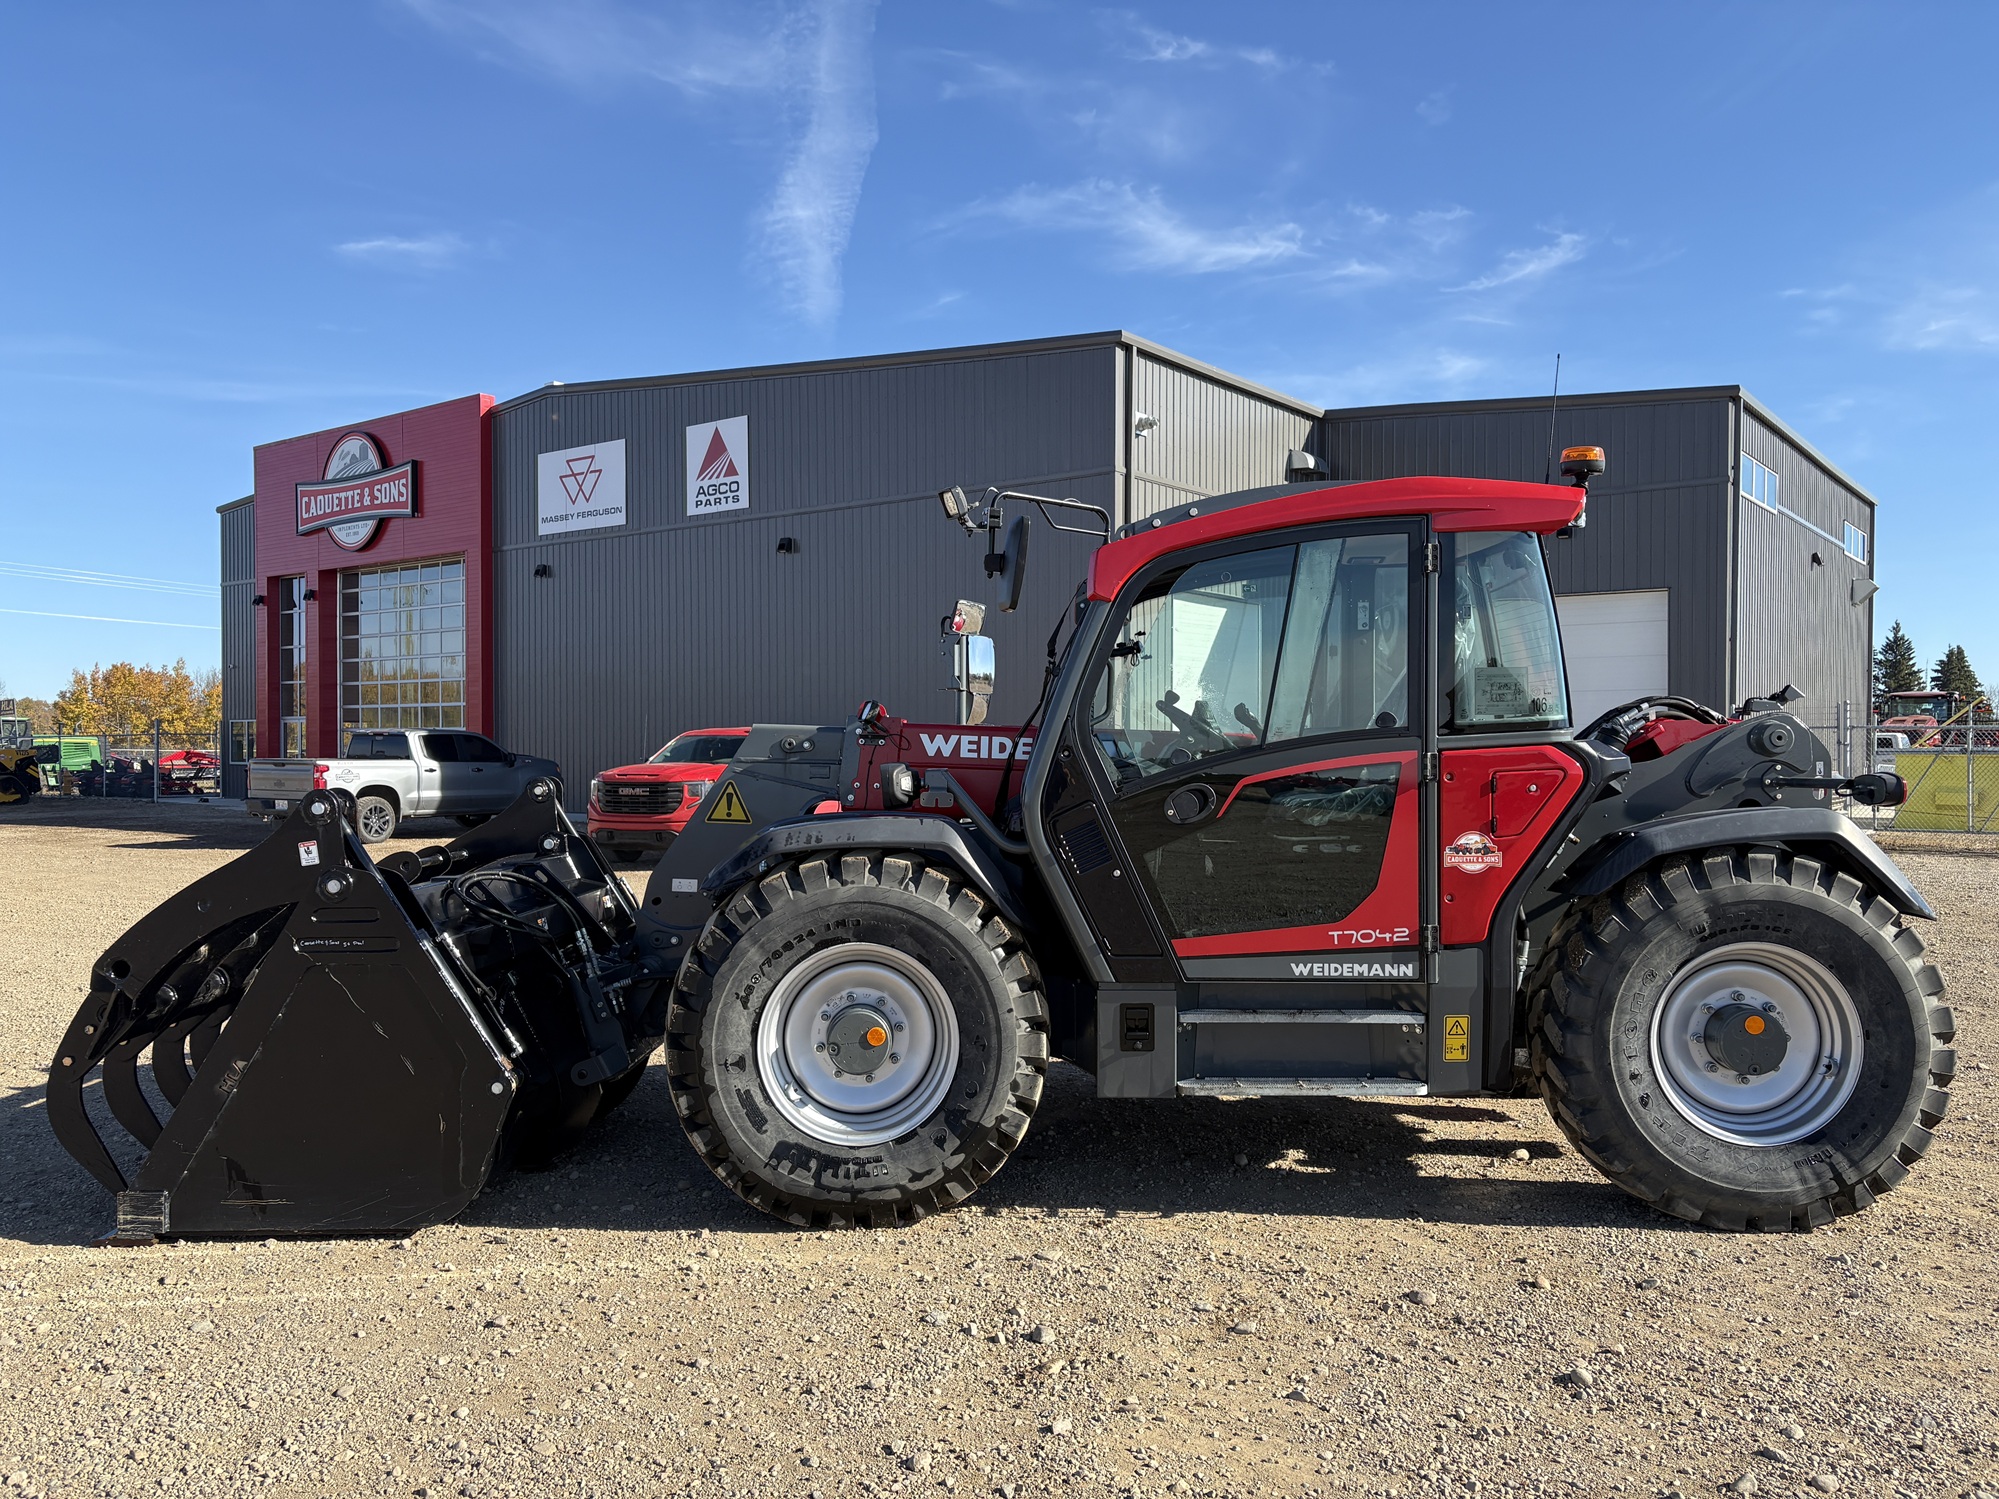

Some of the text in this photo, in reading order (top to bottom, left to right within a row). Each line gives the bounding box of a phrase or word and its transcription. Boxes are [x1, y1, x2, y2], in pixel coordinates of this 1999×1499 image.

[302, 478, 407, 519] CAOUETTE & SONS
[695, 480, 740, 499] AGCO
[695, 494, 740, 509] PARTS
[541, 506, 623, 524] MASSEY FERGUSON
[1532, 697, 1548, 712] 106
[919, 733, 1034, 760] WEIDE
[618, 787, 650, 796] GMC
[1328, 927, 1410, 945] T7042
[1290, 963, 1413, 977] WEIDEMANN
[219, 1060, 248, 1094] HLA
